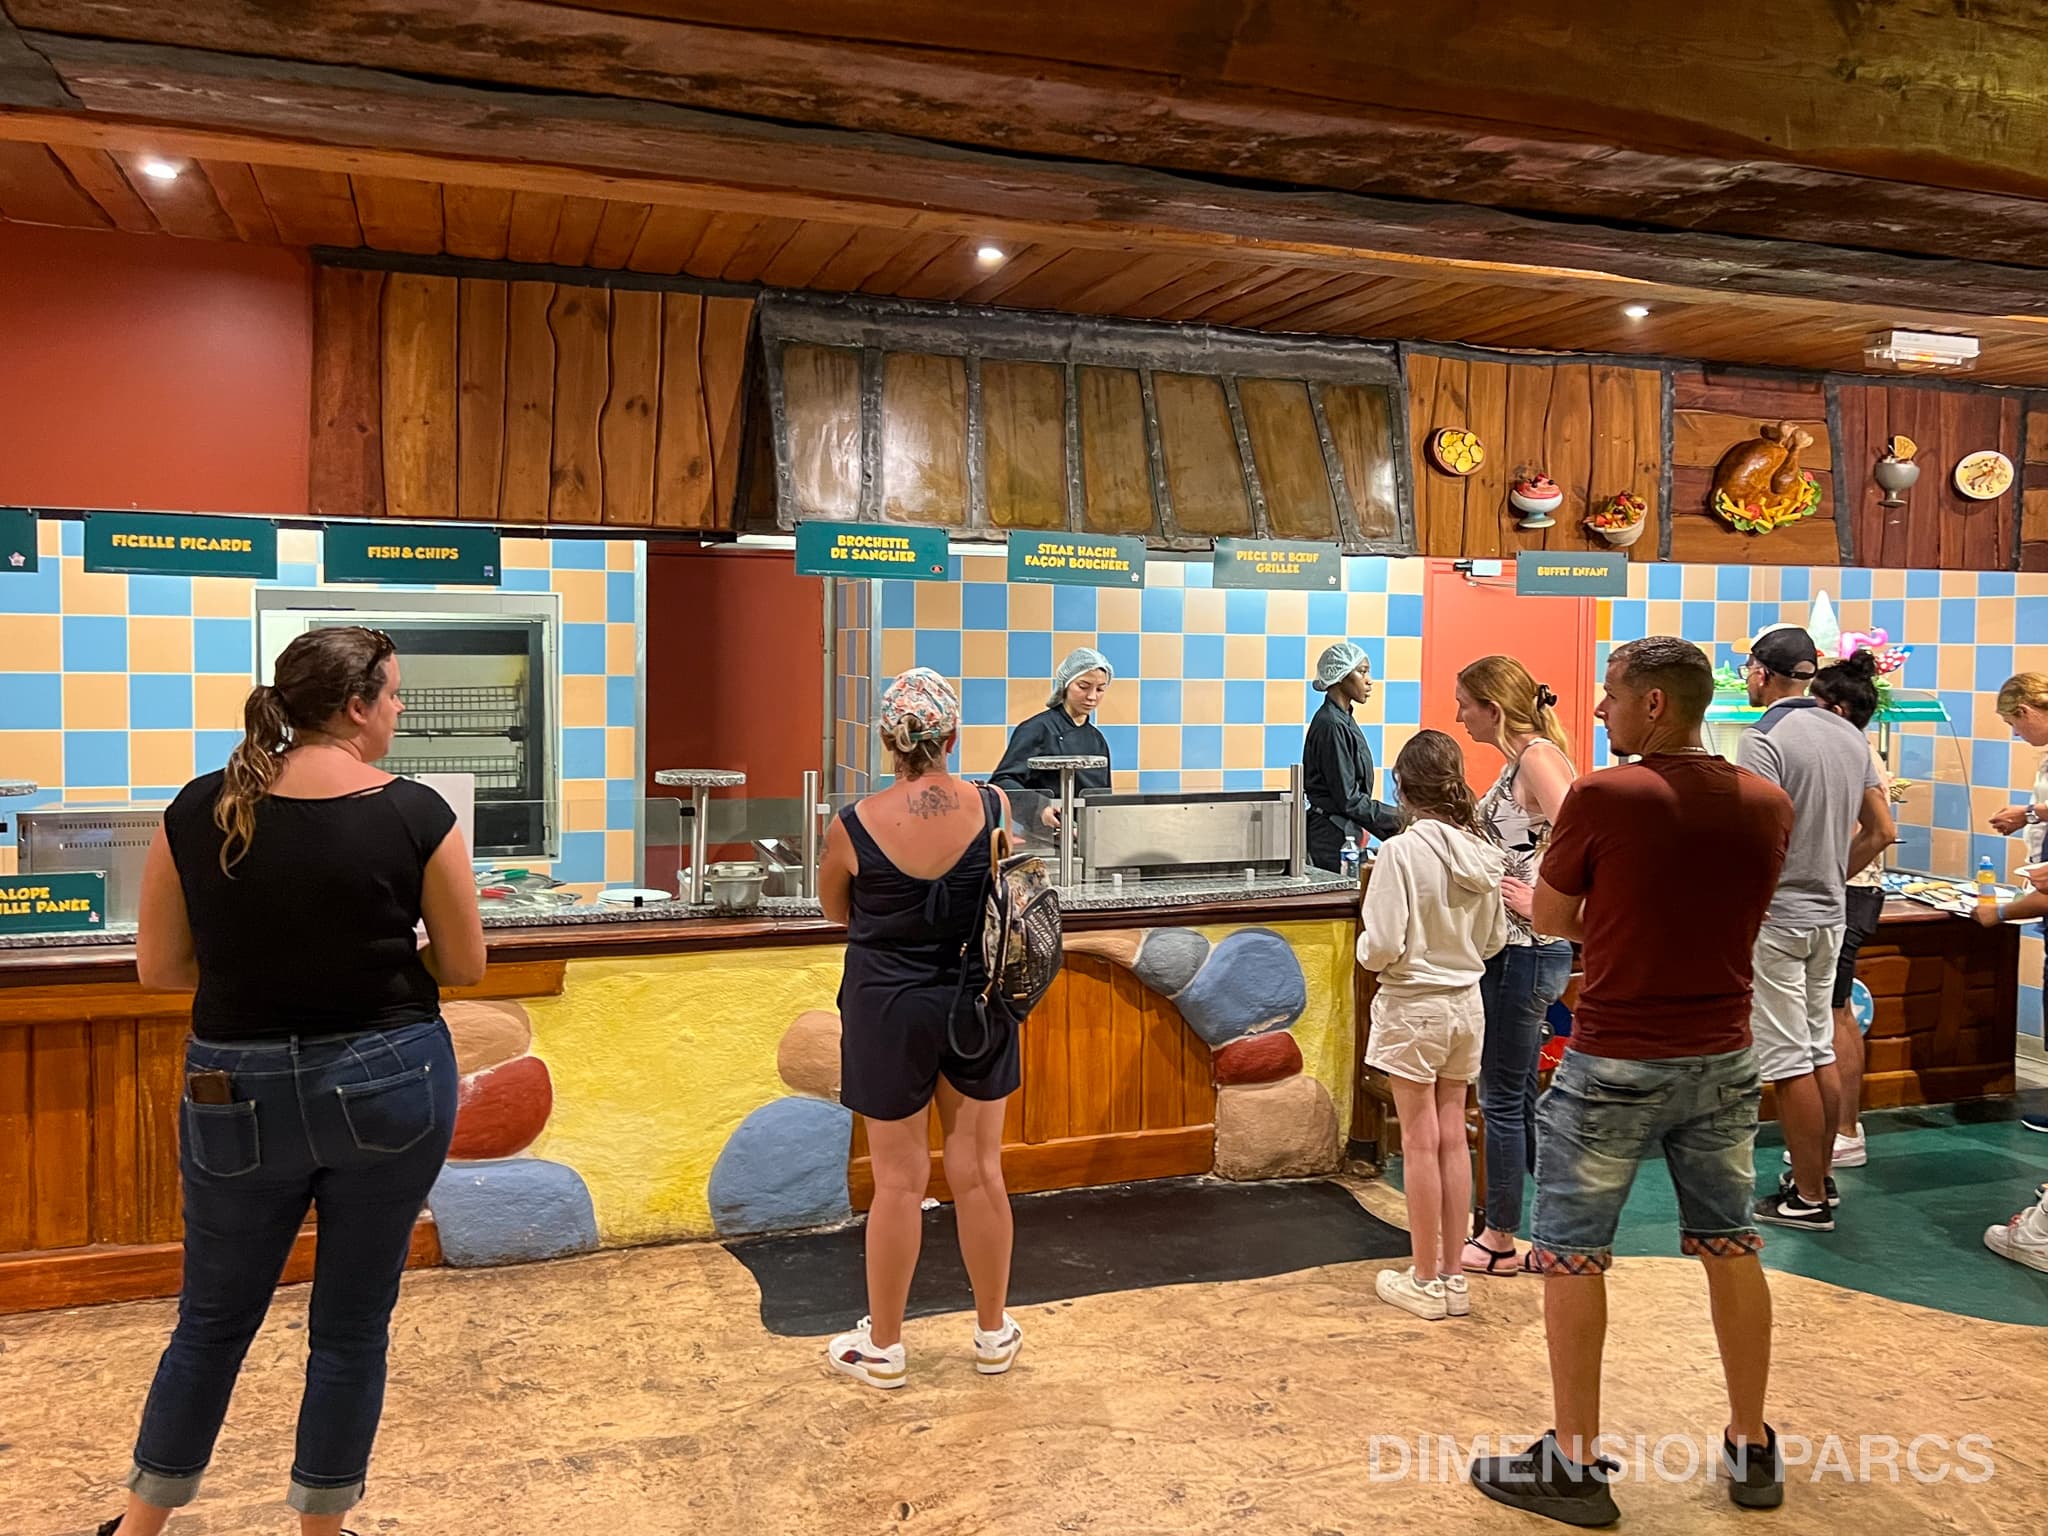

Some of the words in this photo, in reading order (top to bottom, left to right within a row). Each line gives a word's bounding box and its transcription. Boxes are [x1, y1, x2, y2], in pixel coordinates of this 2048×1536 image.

[111, 534, 175, 549] FICELLE
[180, 537, 252, 552] PICARDE
[837, 535, 909, 549] BROCHETTE
[830, 547, 848, 559] DE
[851, 549, 916, 562] SANGLIER
[1038, 543, 1074, 556] STEAK
[1025, 555, 1066, 568] FAÇON
[1271, 552, 1285, 562] DE
[1537, 566, 1571, 577] BUFFET
[1572, 567, 1609, 577] ENFANT
[36, 898, 90, 913] PANÉE
